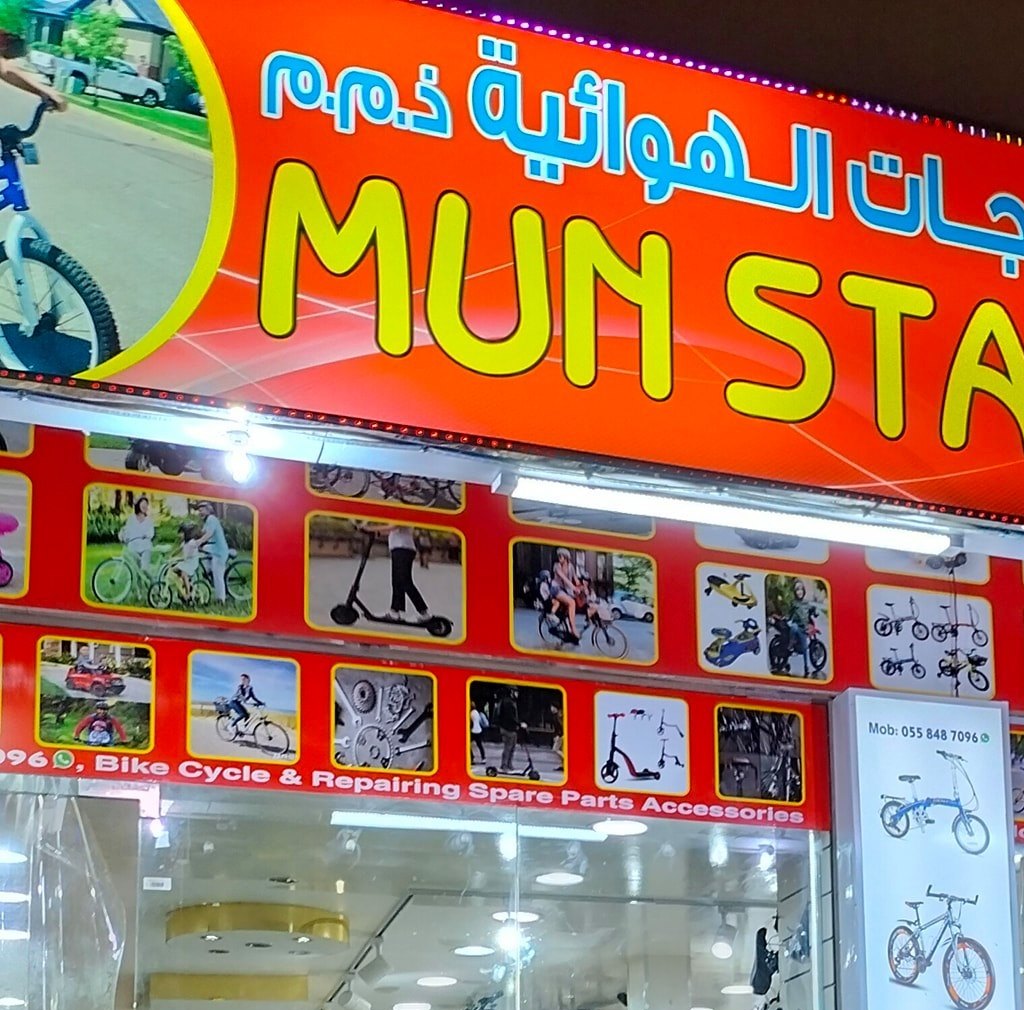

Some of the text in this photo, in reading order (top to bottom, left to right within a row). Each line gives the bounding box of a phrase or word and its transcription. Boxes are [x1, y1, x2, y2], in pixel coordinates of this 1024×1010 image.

[467, 34, 833, 221] الهوائية
[258, 158, 673, 401] MUN
[95, 754, 170, 777] Bike
[178, 761, 272, 784] Cycle
[279, 769, 303, 786] &
[312, 771, 462, 800] Repairing
[468, 783, 554, 804] Spare
[561, 790, 634, 811] Parts
[641, 796, 805, 825] Accessories
[868, 722, 979, 743] Mob: 055 848 7096
